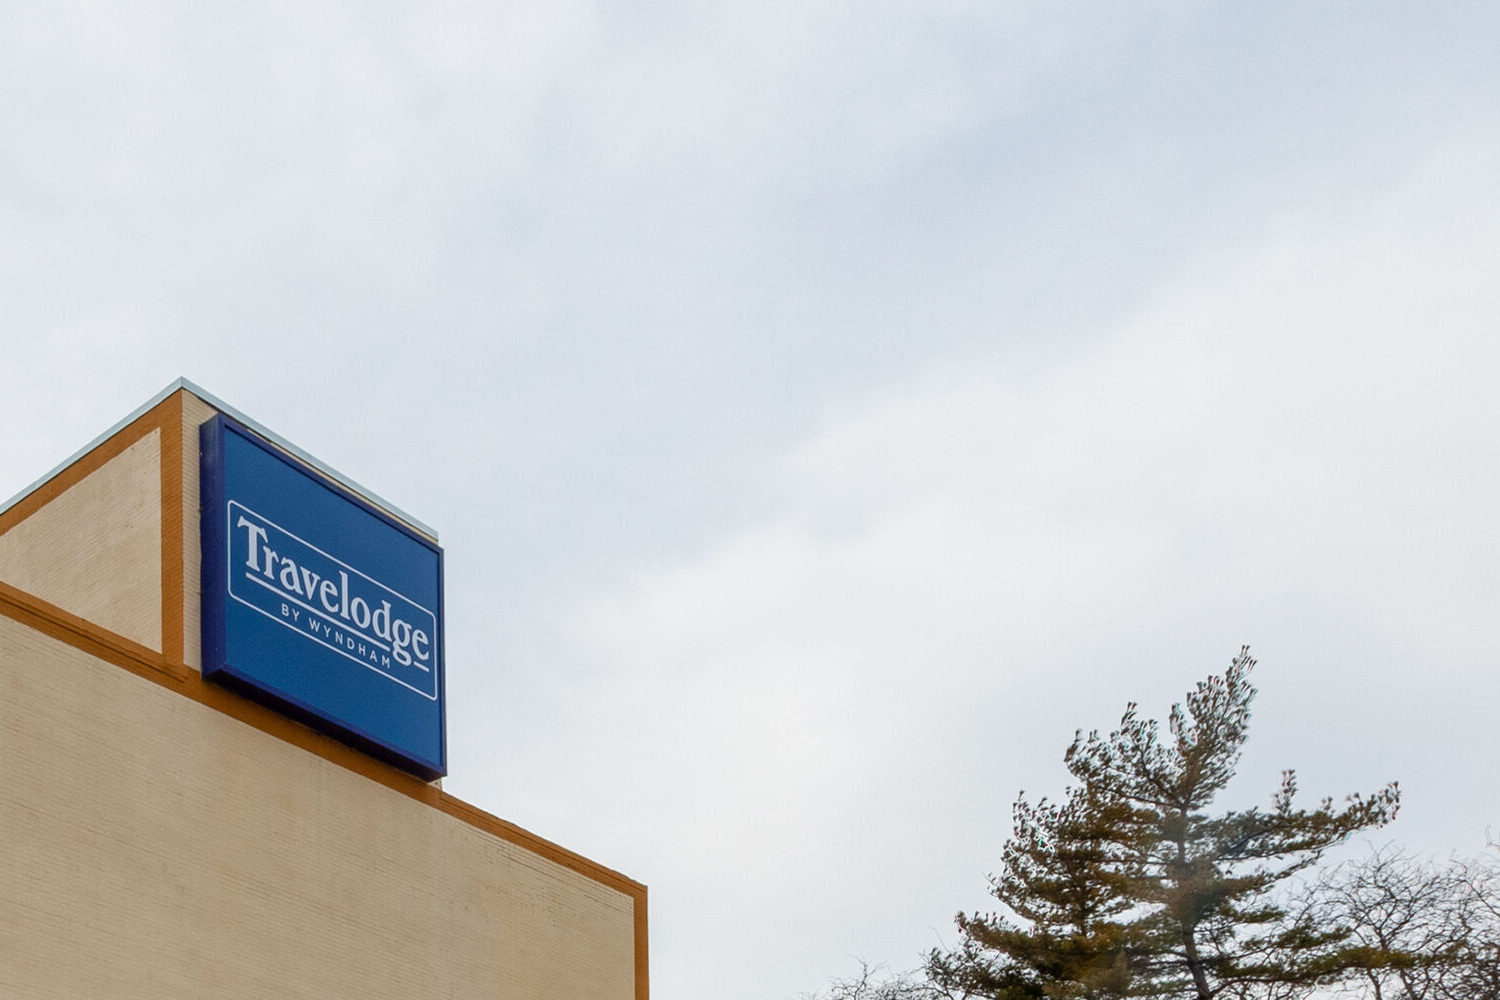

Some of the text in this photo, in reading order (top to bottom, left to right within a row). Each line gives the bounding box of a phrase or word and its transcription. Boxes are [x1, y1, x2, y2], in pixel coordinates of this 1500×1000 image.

[237, 515, 430, 667] Travelodge
[281, 603, 391, 669] BY WYNDHAM
